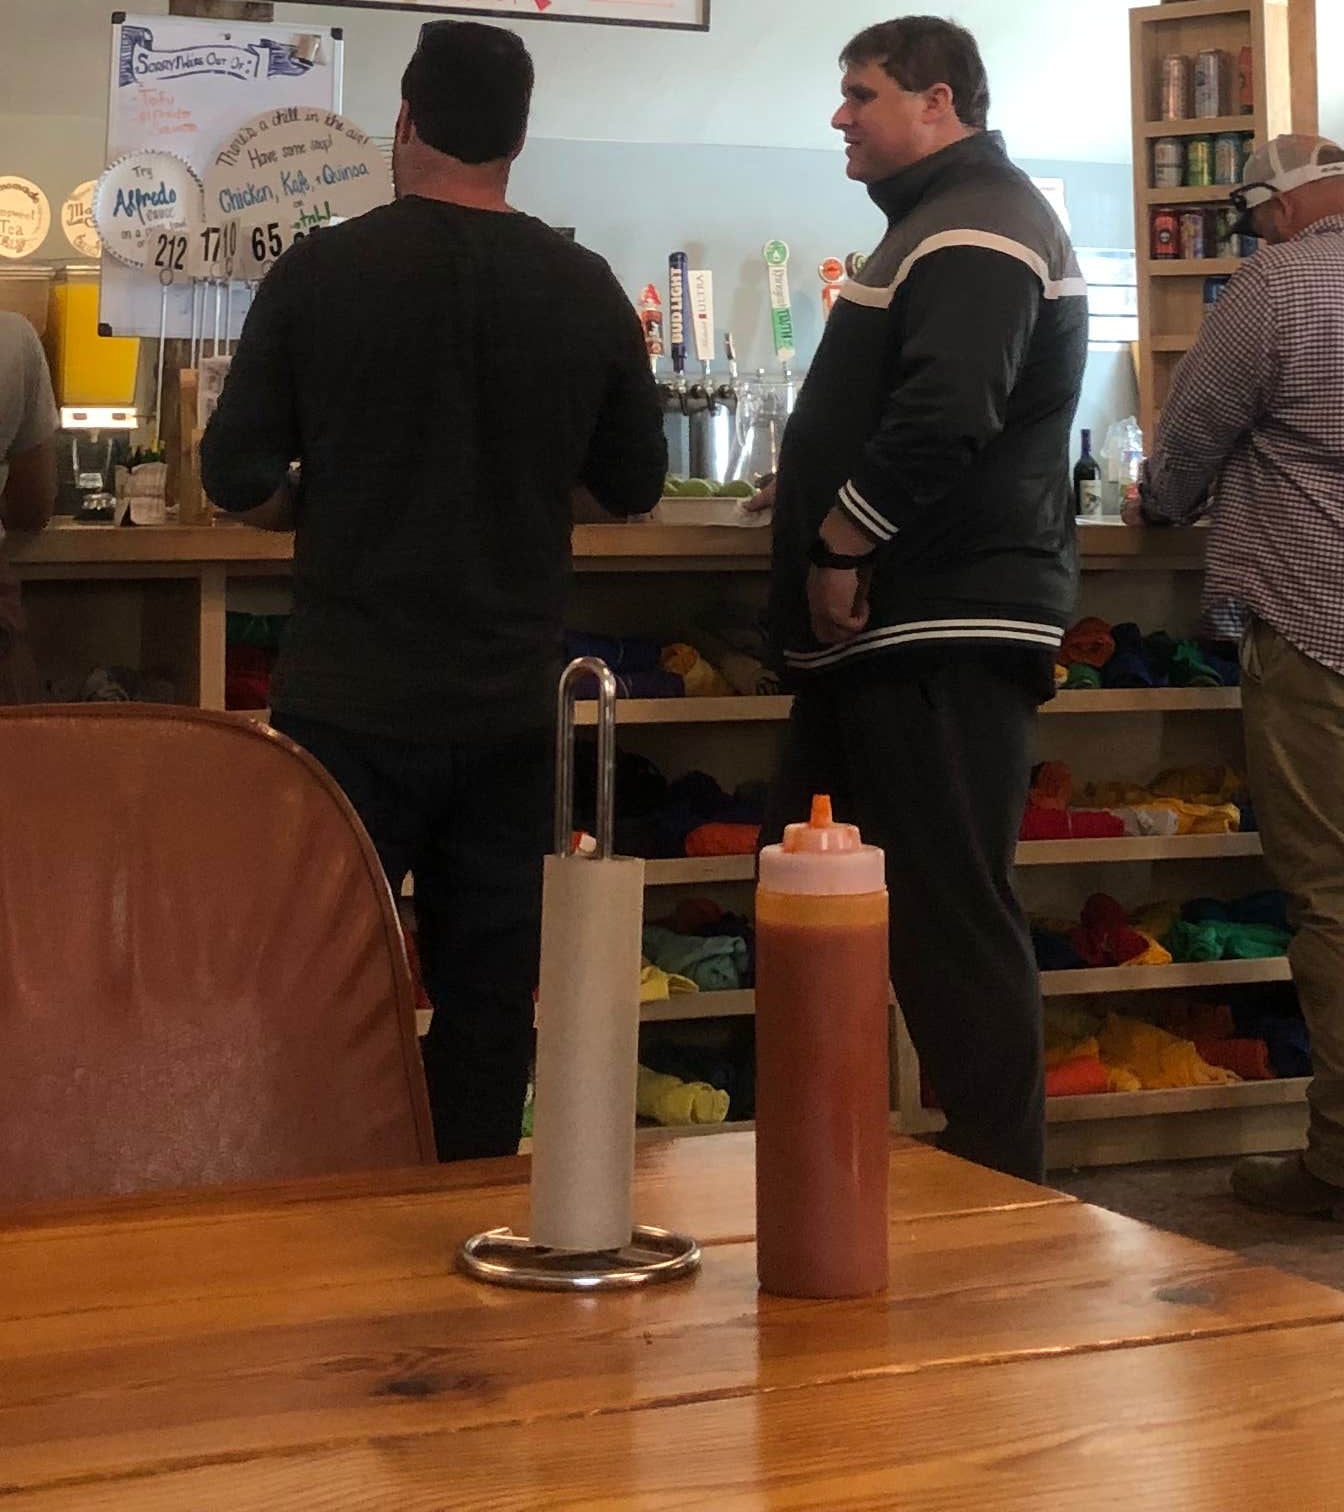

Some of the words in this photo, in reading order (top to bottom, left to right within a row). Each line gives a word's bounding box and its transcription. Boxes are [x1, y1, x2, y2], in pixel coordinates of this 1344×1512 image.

[134, 166, 153, 181] Try
[247, 146, 278, 169] Have
[283, 143, 307, 159] some
[323, 161, 369, 186] Quinoa
[112, 180, 177, 226] Alfredo
[154, 232, 188, 271] 212
[251, 222, 283, 262] 65
[670, 268, 683, 310] LIGHT
[694, 273, 707, 315] ULTRA
[670, 311, 683, 344] BUD
